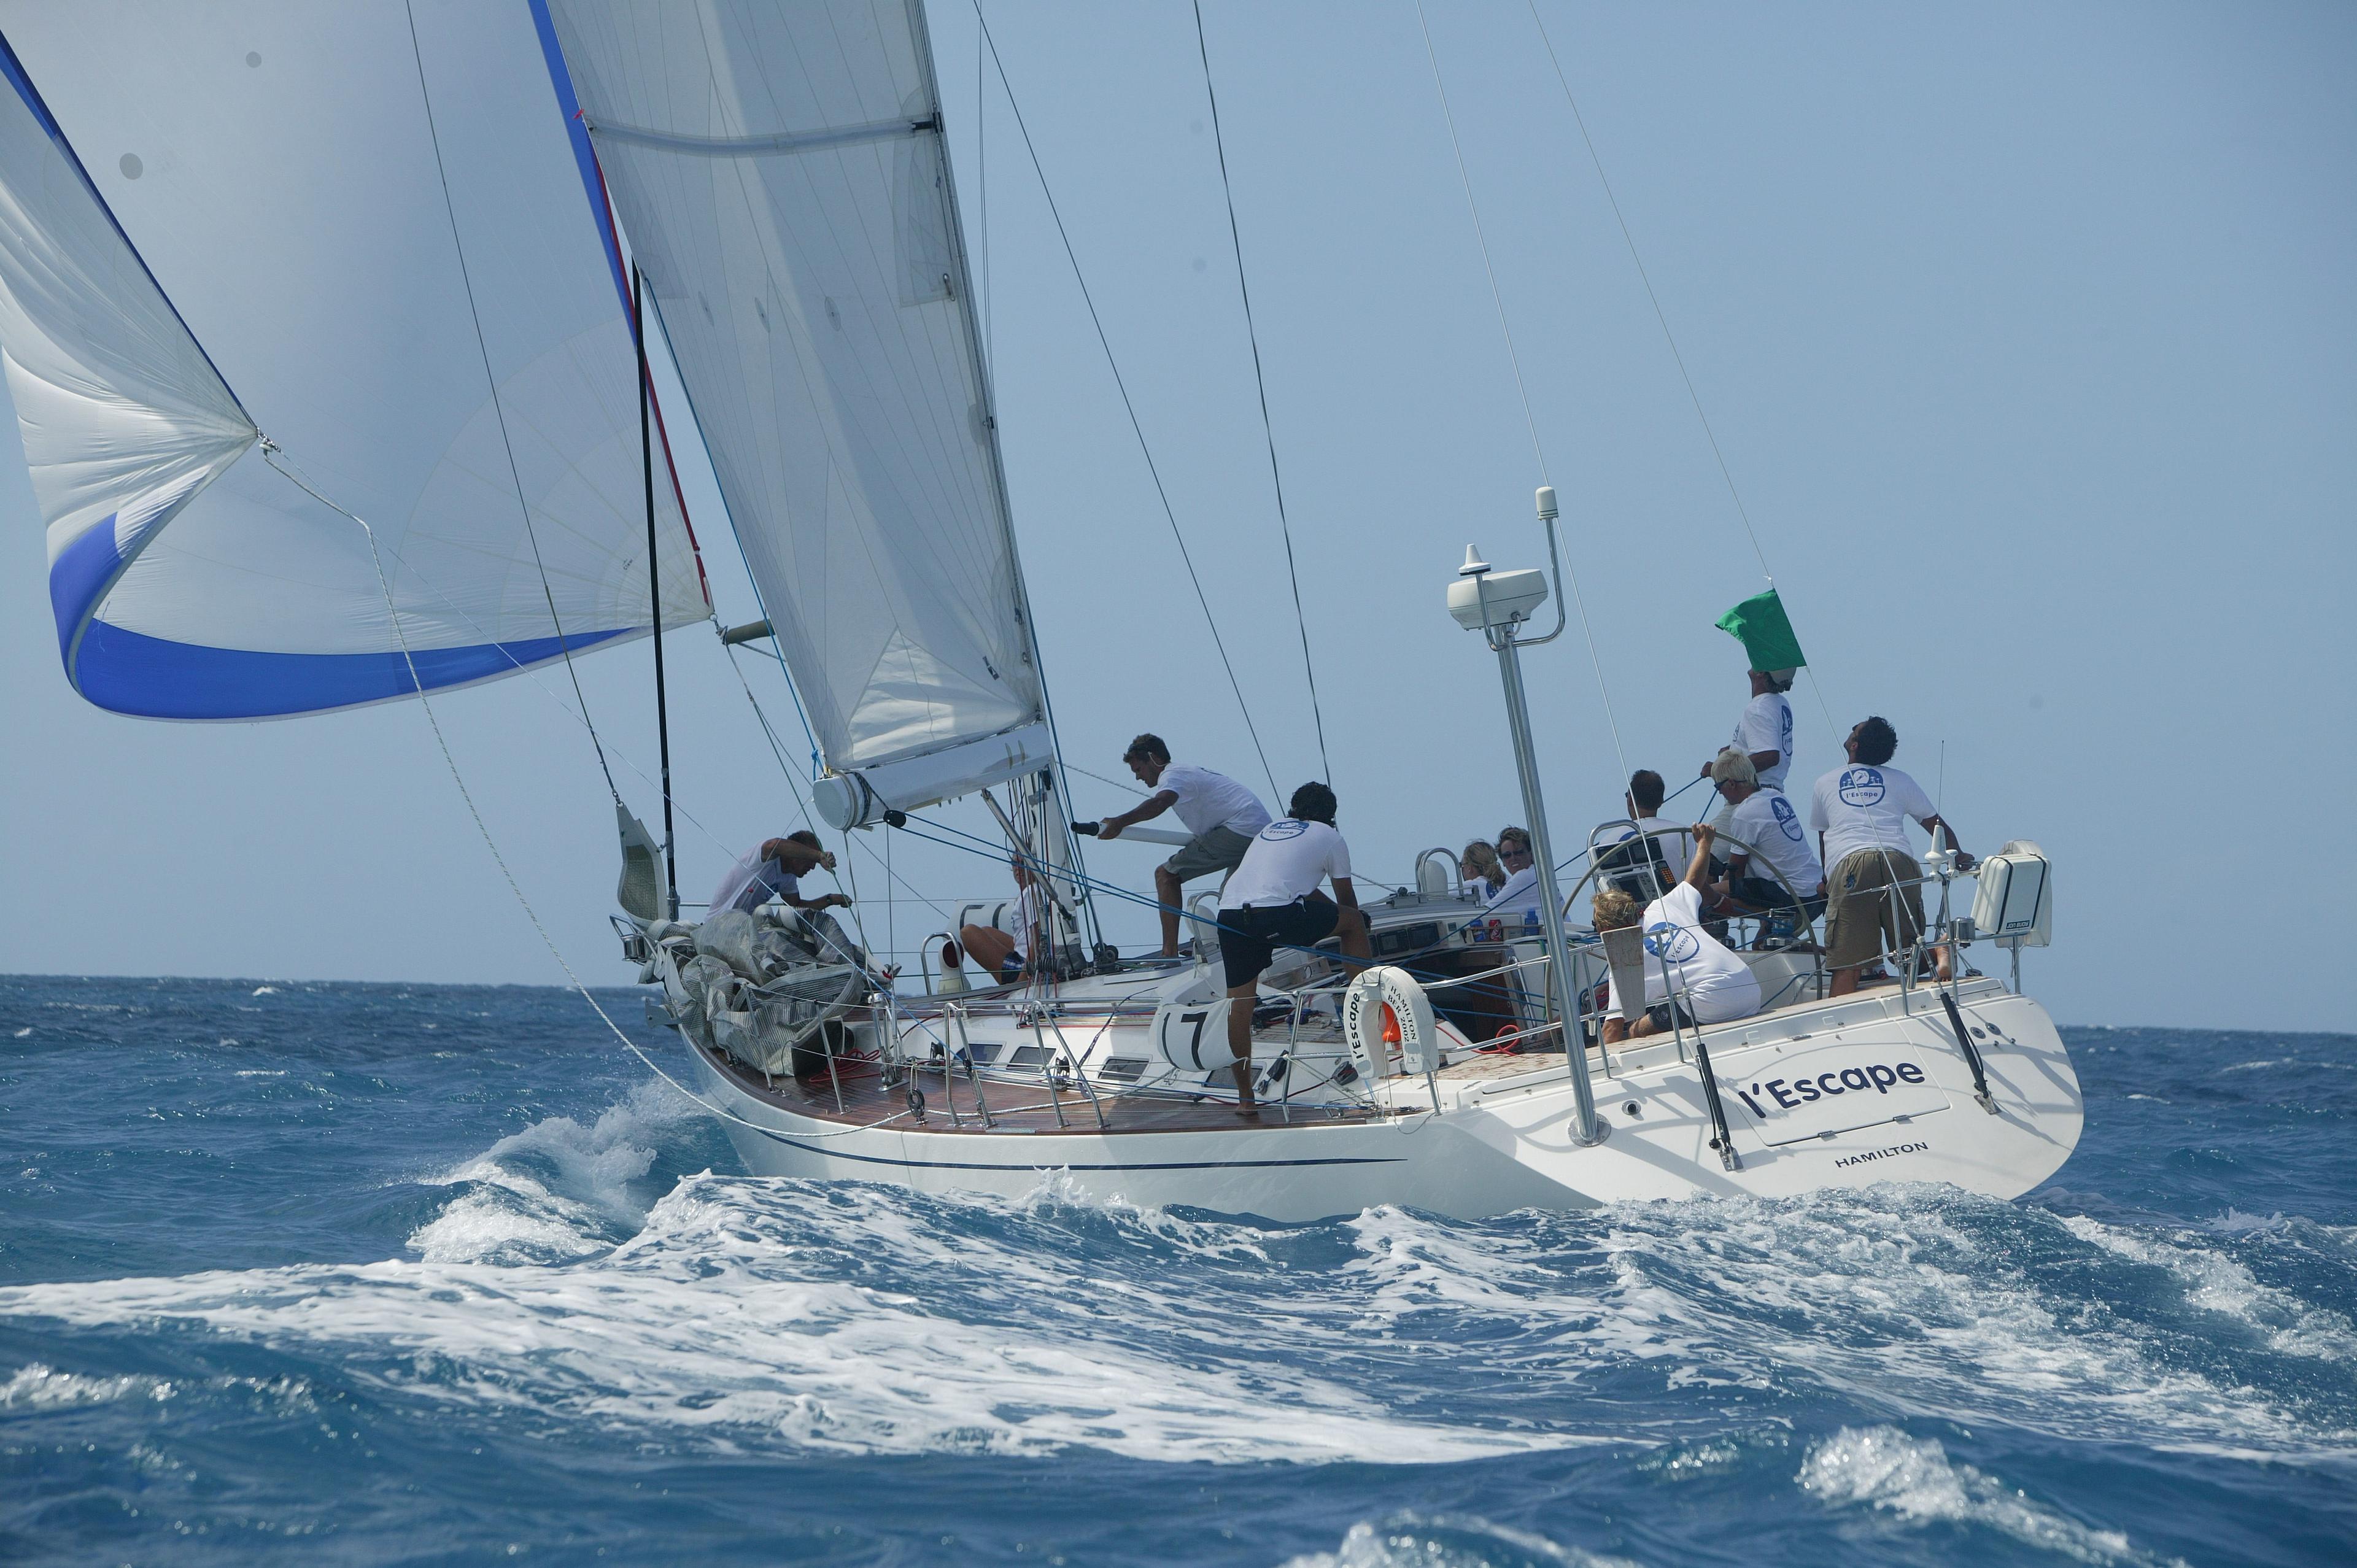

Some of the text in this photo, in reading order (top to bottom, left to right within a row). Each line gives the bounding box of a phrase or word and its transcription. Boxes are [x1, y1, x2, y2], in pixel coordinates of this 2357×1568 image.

[1162, 1011, 1209, 1070] 17
[1350, 993, 1364, 1059] l'Escape
[1388, 994, 1410, 1042] BER 2002
[1390, 986, 1417, 1040] HAMILTON
[1738, 1061, 1925, 1119] l'Escape
[1834, 1141, 1929, 1168] HAMILTON
